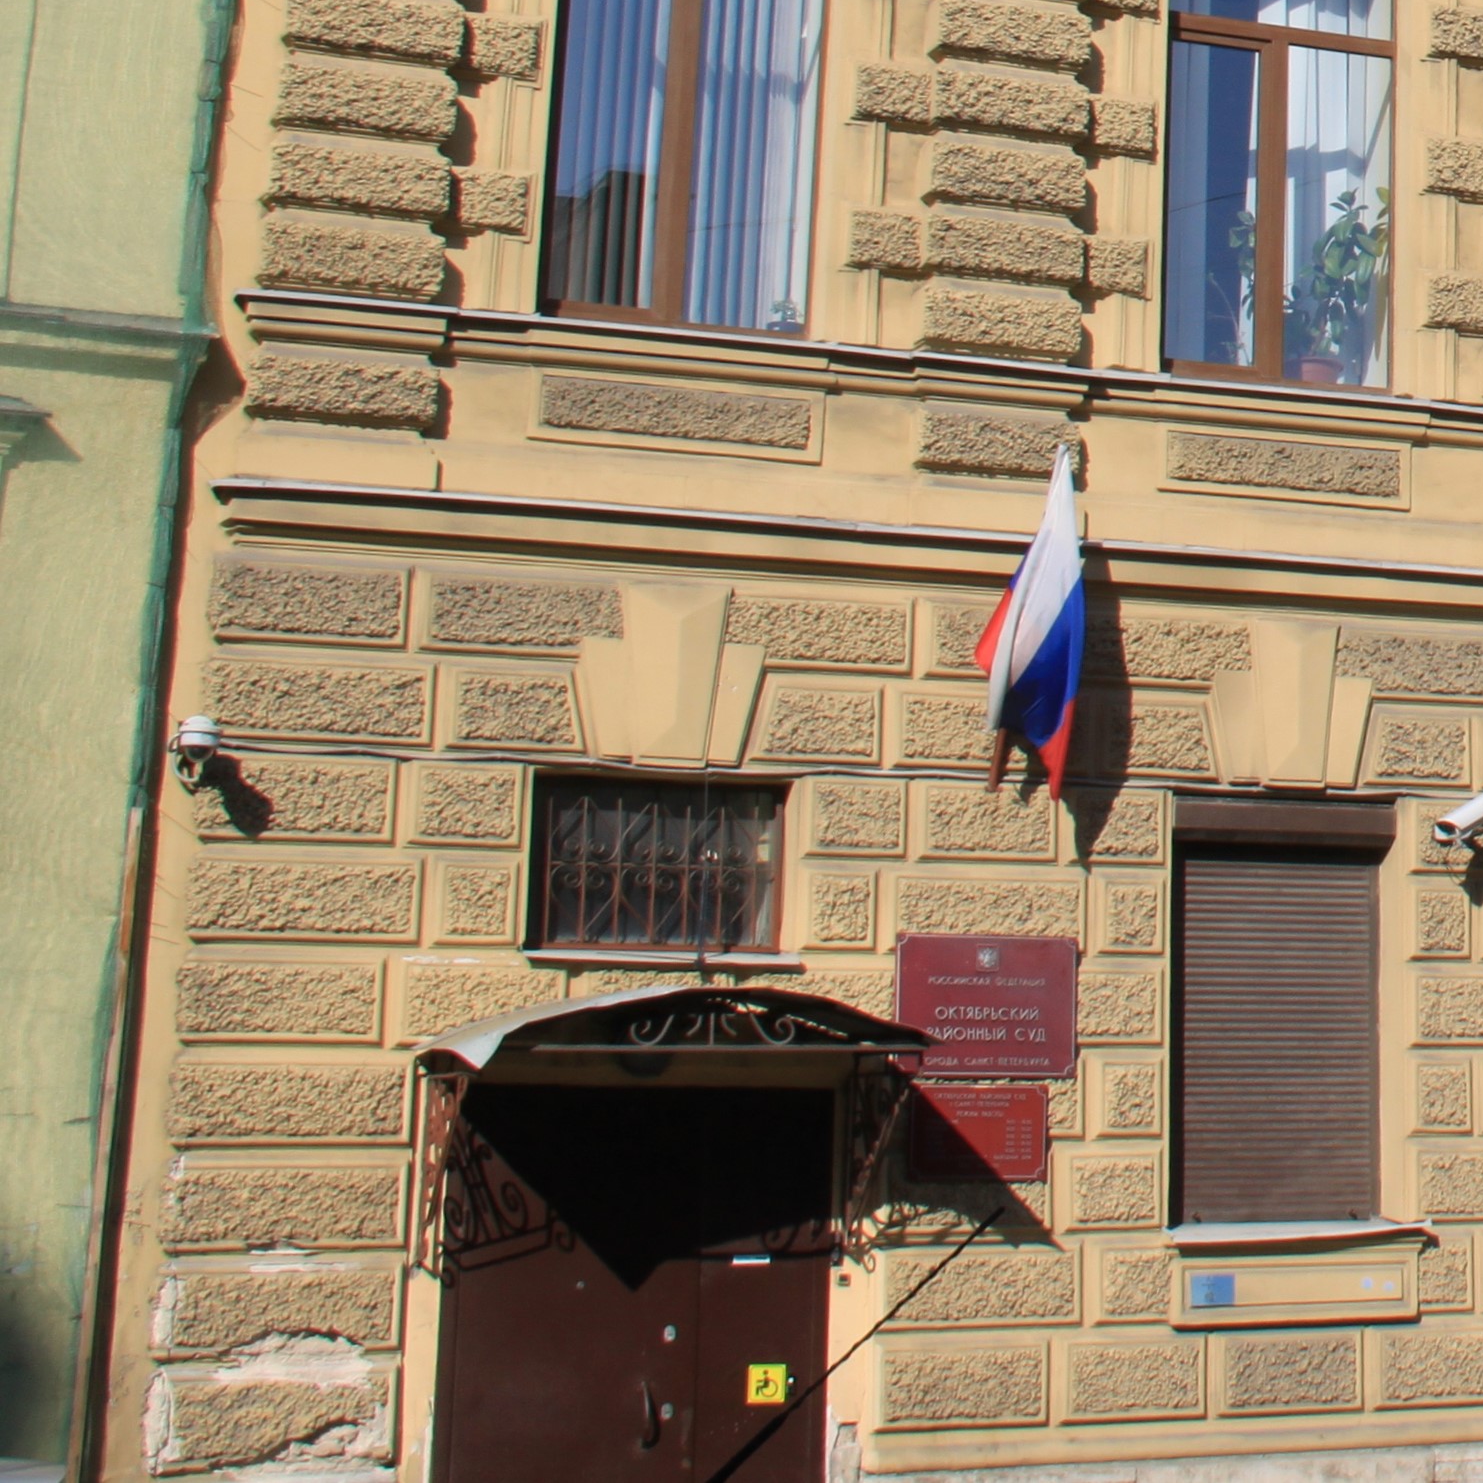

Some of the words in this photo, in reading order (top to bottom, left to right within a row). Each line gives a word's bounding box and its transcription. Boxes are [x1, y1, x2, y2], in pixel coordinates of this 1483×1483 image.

[935, 1006, 1039, 1020] ОКТЯБРЬСКИЙ
[1015, 1027, 1047, 1042] СУД
[924, 1057, 959, 1067] ОРОДА
